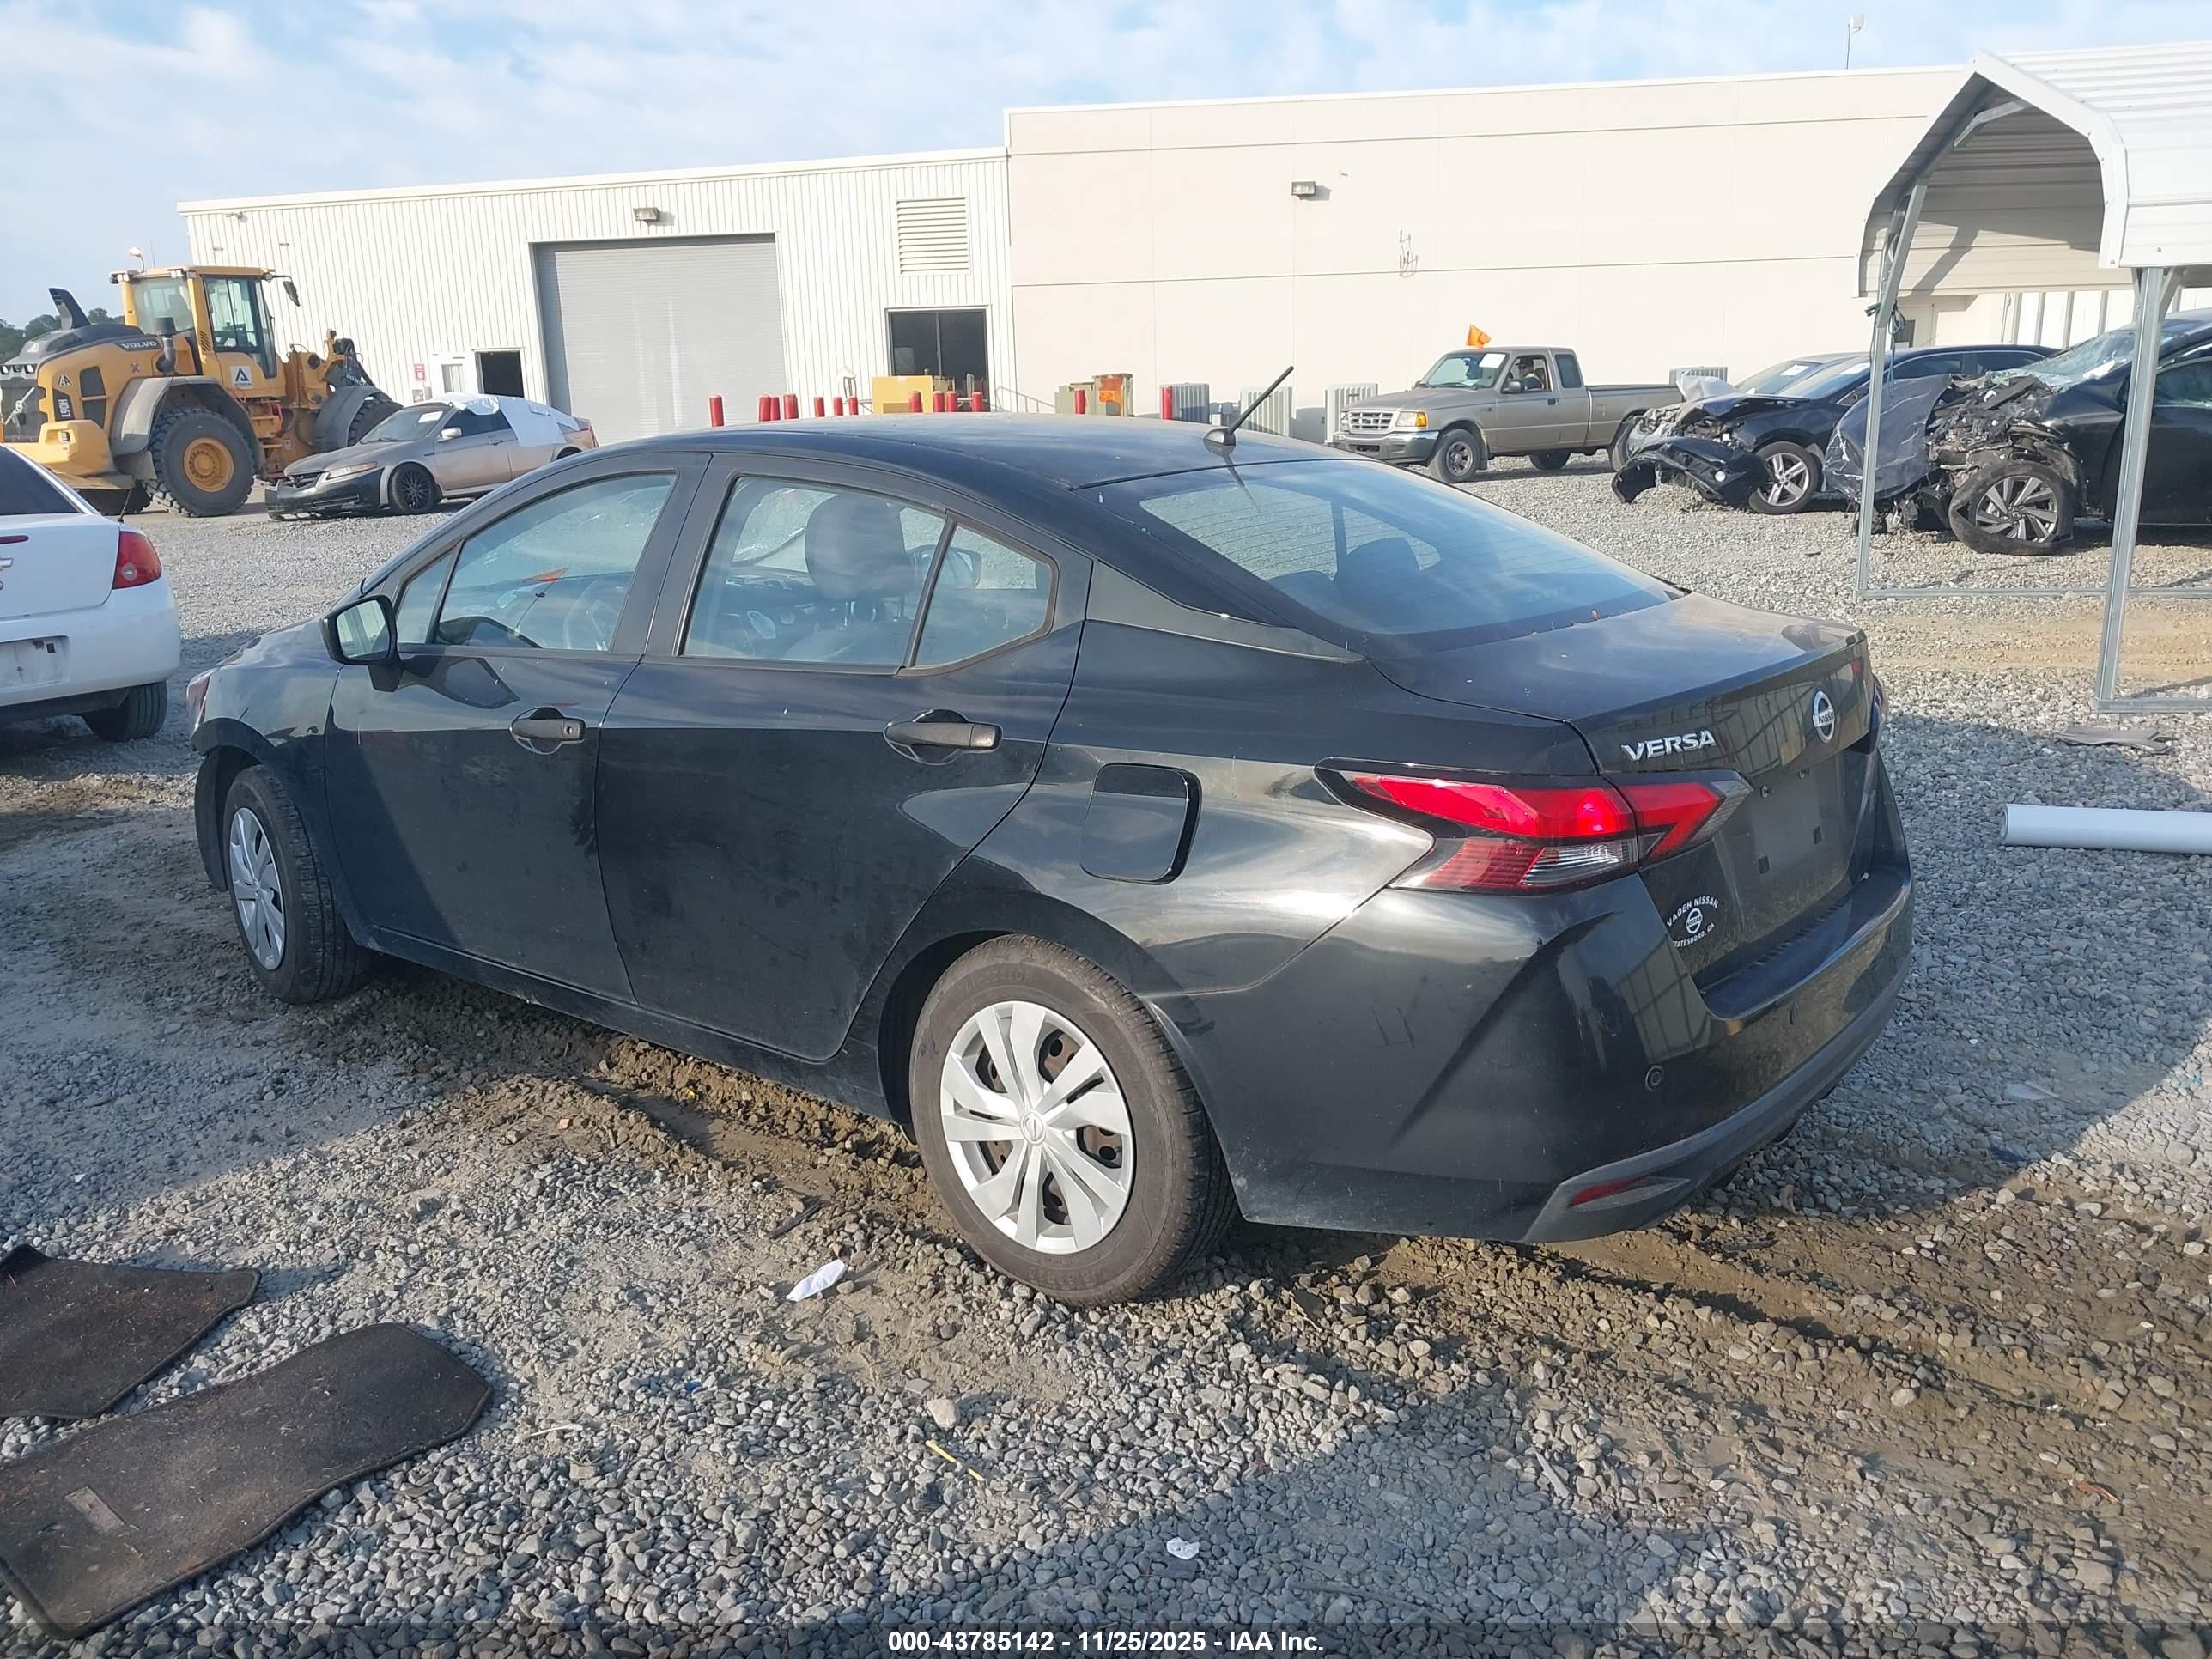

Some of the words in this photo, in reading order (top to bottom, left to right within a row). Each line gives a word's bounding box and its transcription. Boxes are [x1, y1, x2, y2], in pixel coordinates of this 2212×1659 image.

[346, 373, 355, 381] DO
[1621, 730, 1717, 761] VERSA
[1667, 900, 1692, 927] VADEN
[1693, 896, 1719, 908] NISSAN
